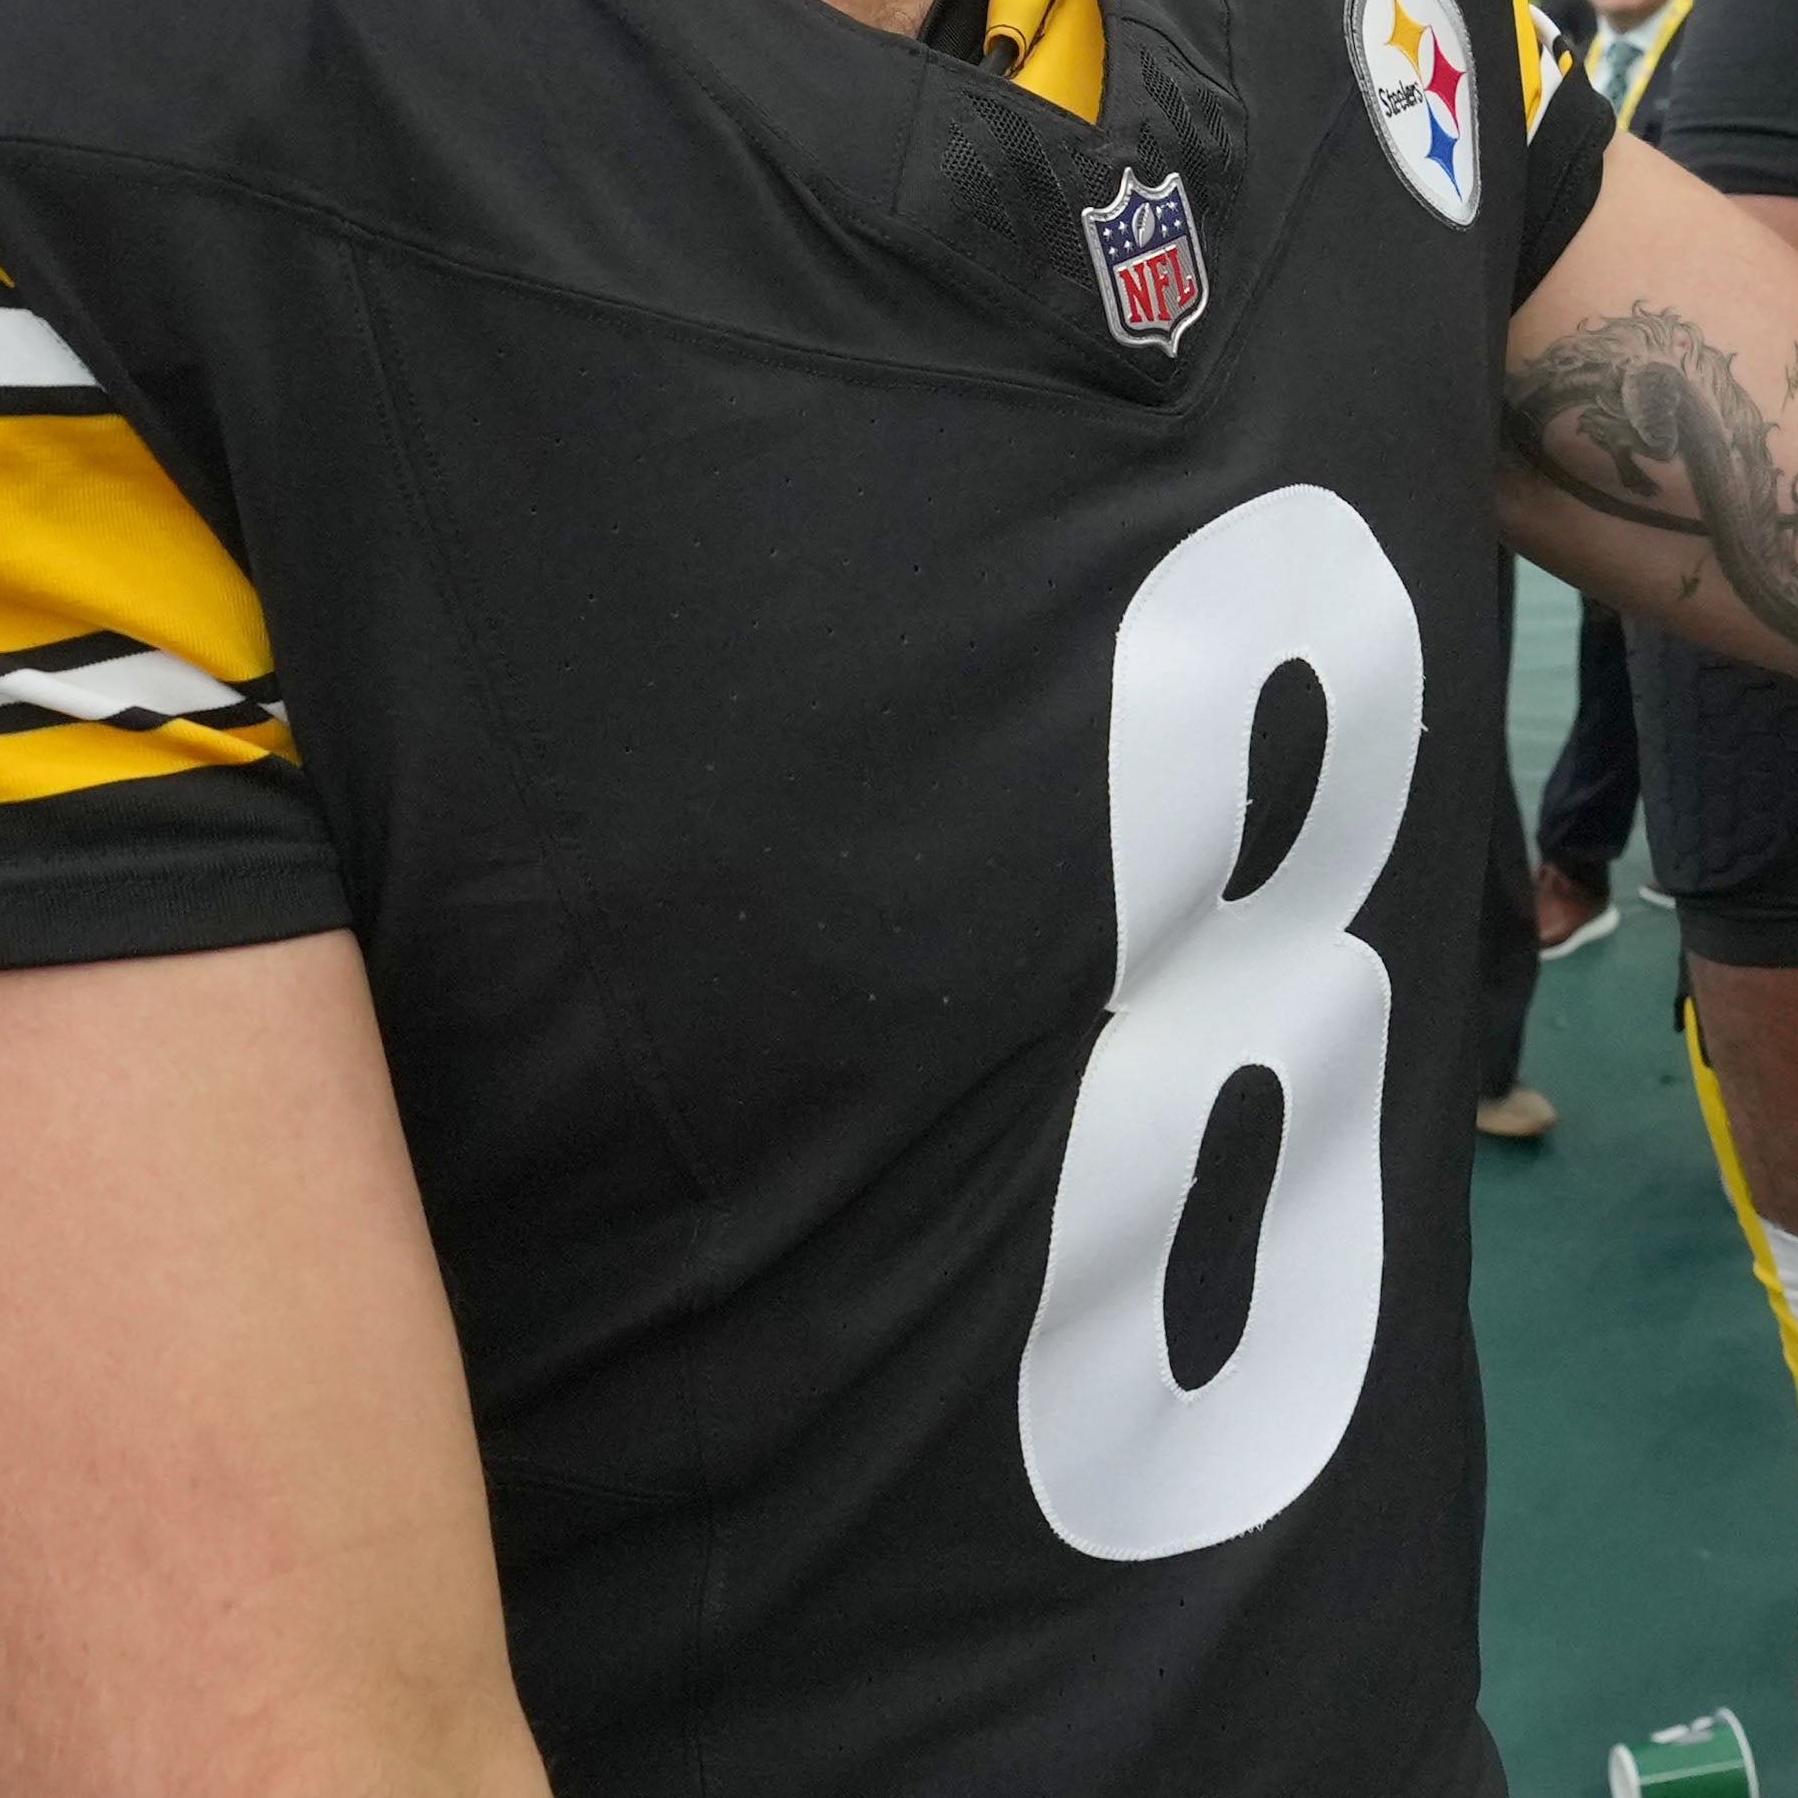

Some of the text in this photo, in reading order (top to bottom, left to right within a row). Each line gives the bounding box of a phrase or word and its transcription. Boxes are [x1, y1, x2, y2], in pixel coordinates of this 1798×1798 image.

[1378, 80, 1424, 118] Steelers
[1118, 247, 1196, 323] NFL
[1017, 483, 1424, 1561] 8
